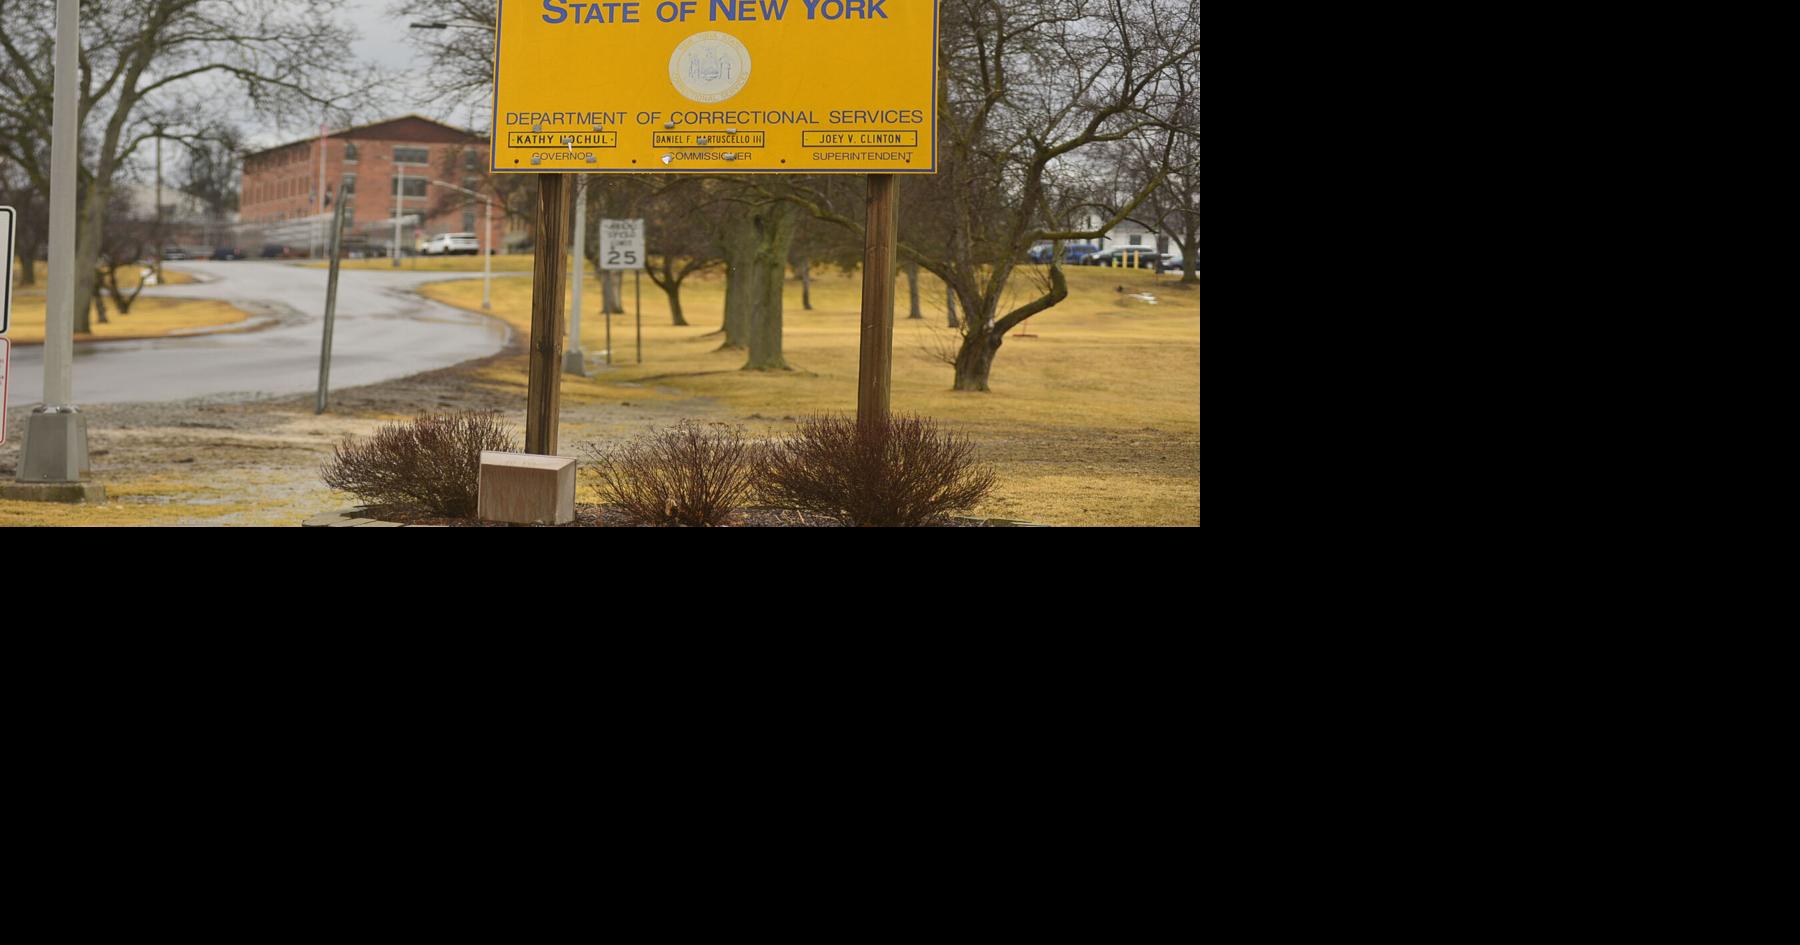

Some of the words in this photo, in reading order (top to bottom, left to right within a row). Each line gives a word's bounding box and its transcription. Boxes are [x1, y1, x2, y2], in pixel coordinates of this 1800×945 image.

[656, 1, 696, 23] OF
[506, 111, 627, 125] DEPARTMENT
[636, 111, 661, 125] OF
[670, 110, 820, 125] CORRECTIONAL
[828, 109, 923, 124] SERVICES
[516, 135, 554, 144] KATHY
[656, 135, 682, 144] DANIEL
[820, 134, 844, 144] JOEY
[847, 134, 857, 144] V.
[860, 134, 902, 144] CLINTON
[812, 152, 913, 161] SUPERINTENDENT
[608, 250, 636, 264] 25
